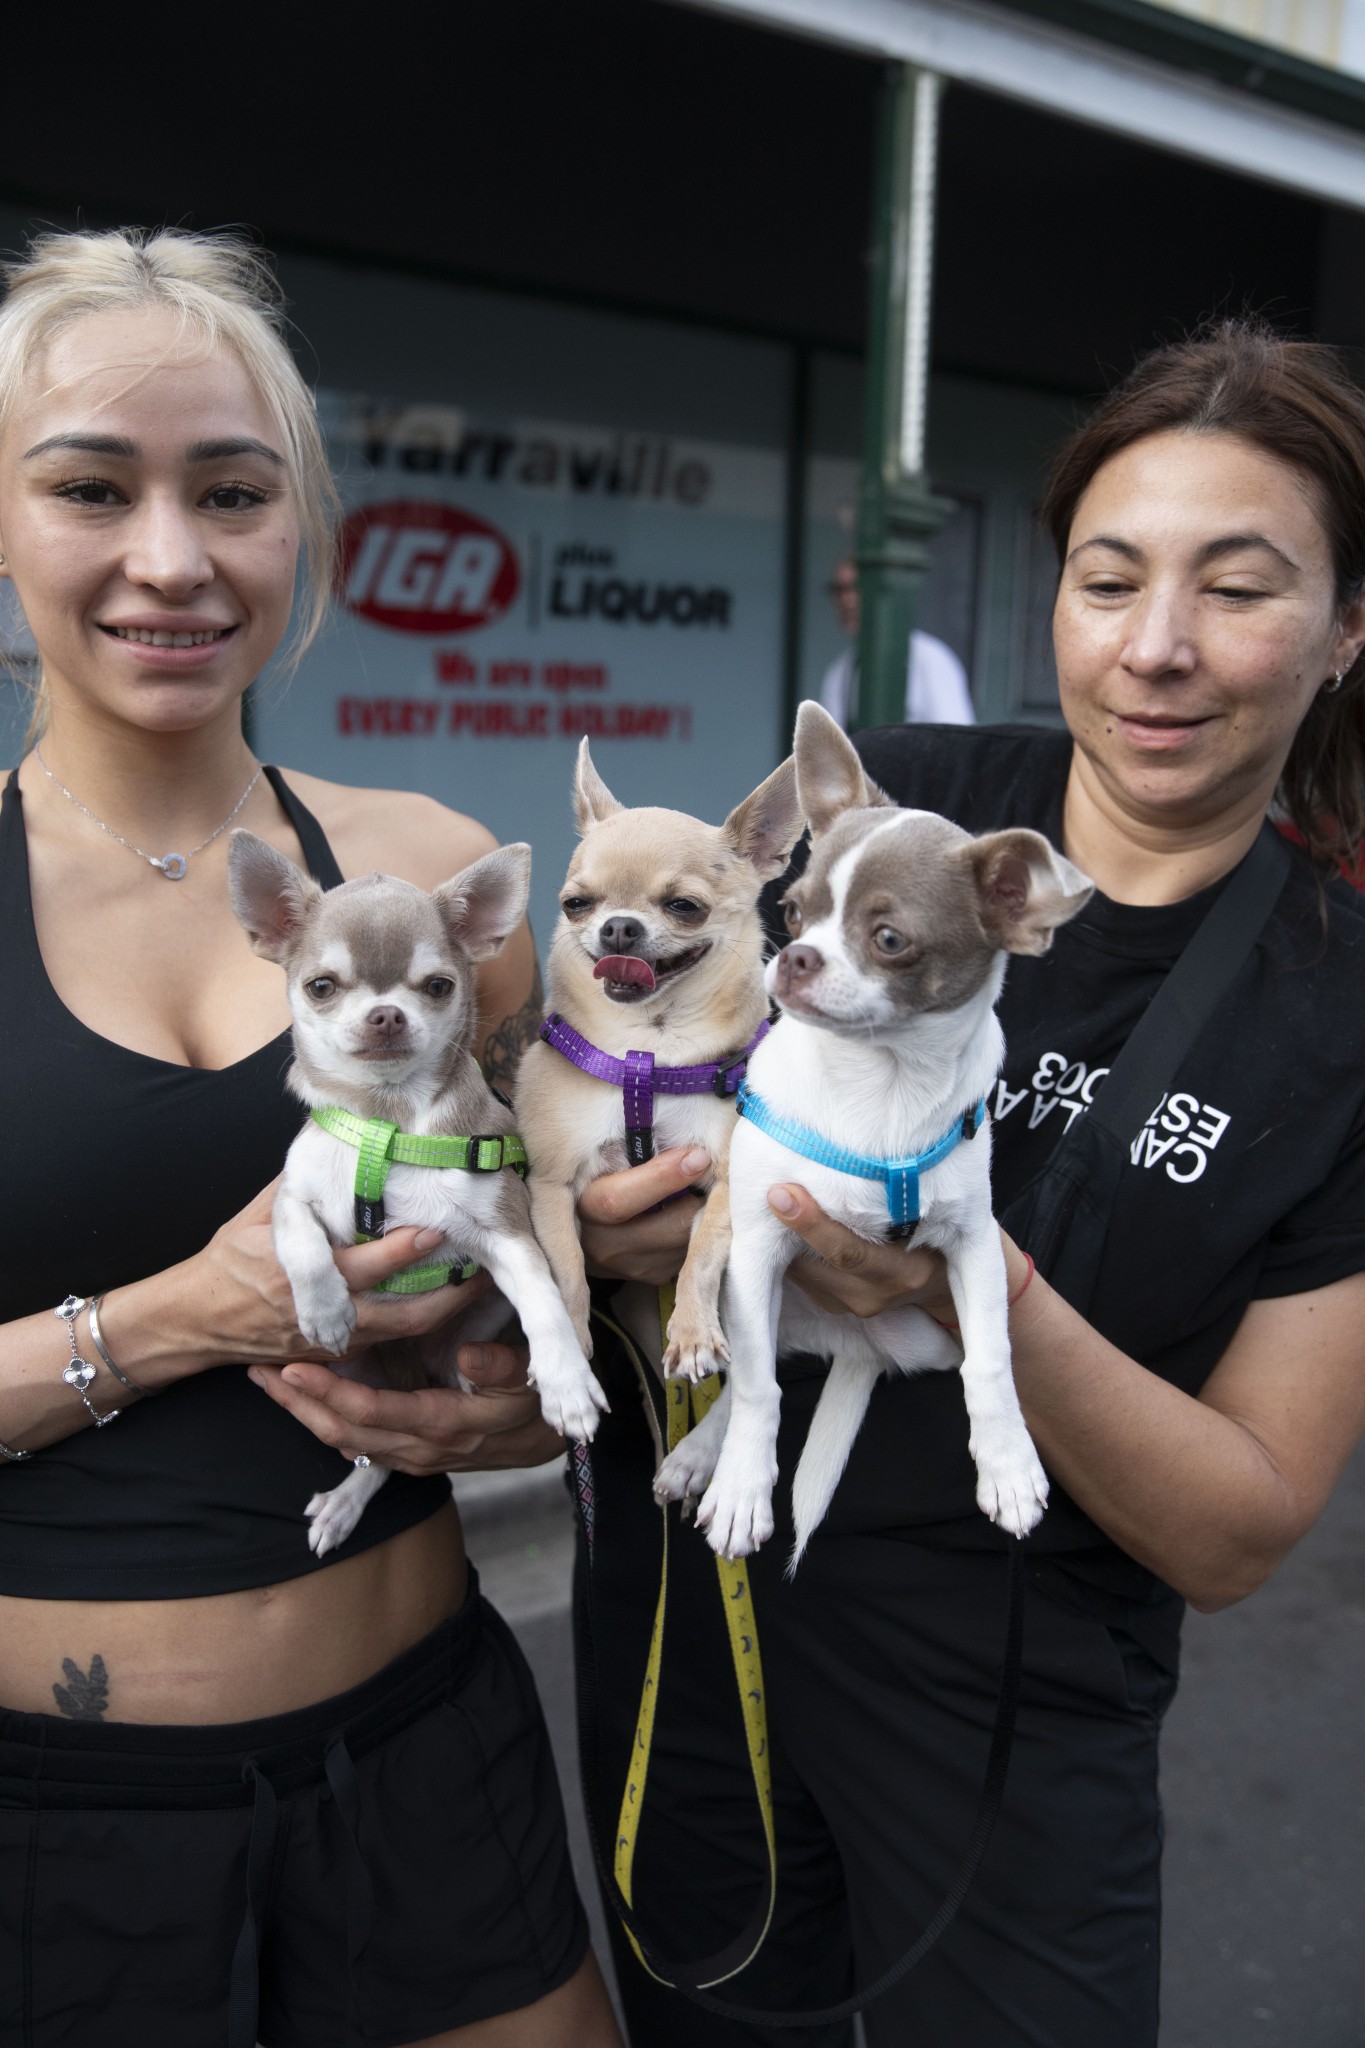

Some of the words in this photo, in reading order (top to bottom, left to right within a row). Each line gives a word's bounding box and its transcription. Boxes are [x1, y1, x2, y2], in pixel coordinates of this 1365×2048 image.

[347, 525, 500, 616] IGA
[549, 576, 735, 631] LIQUOR
[433, 650, 479, 686] We
[488, 659, 532, 687] are
[541, 661, 611, 694] open
[337, 698, 442, 737] EVERY
[450, 702, 548, 738] PUBLIC
[556, 703, 671, 740] HOLIDAY
[635, 1136, 643, 1159] rogz
